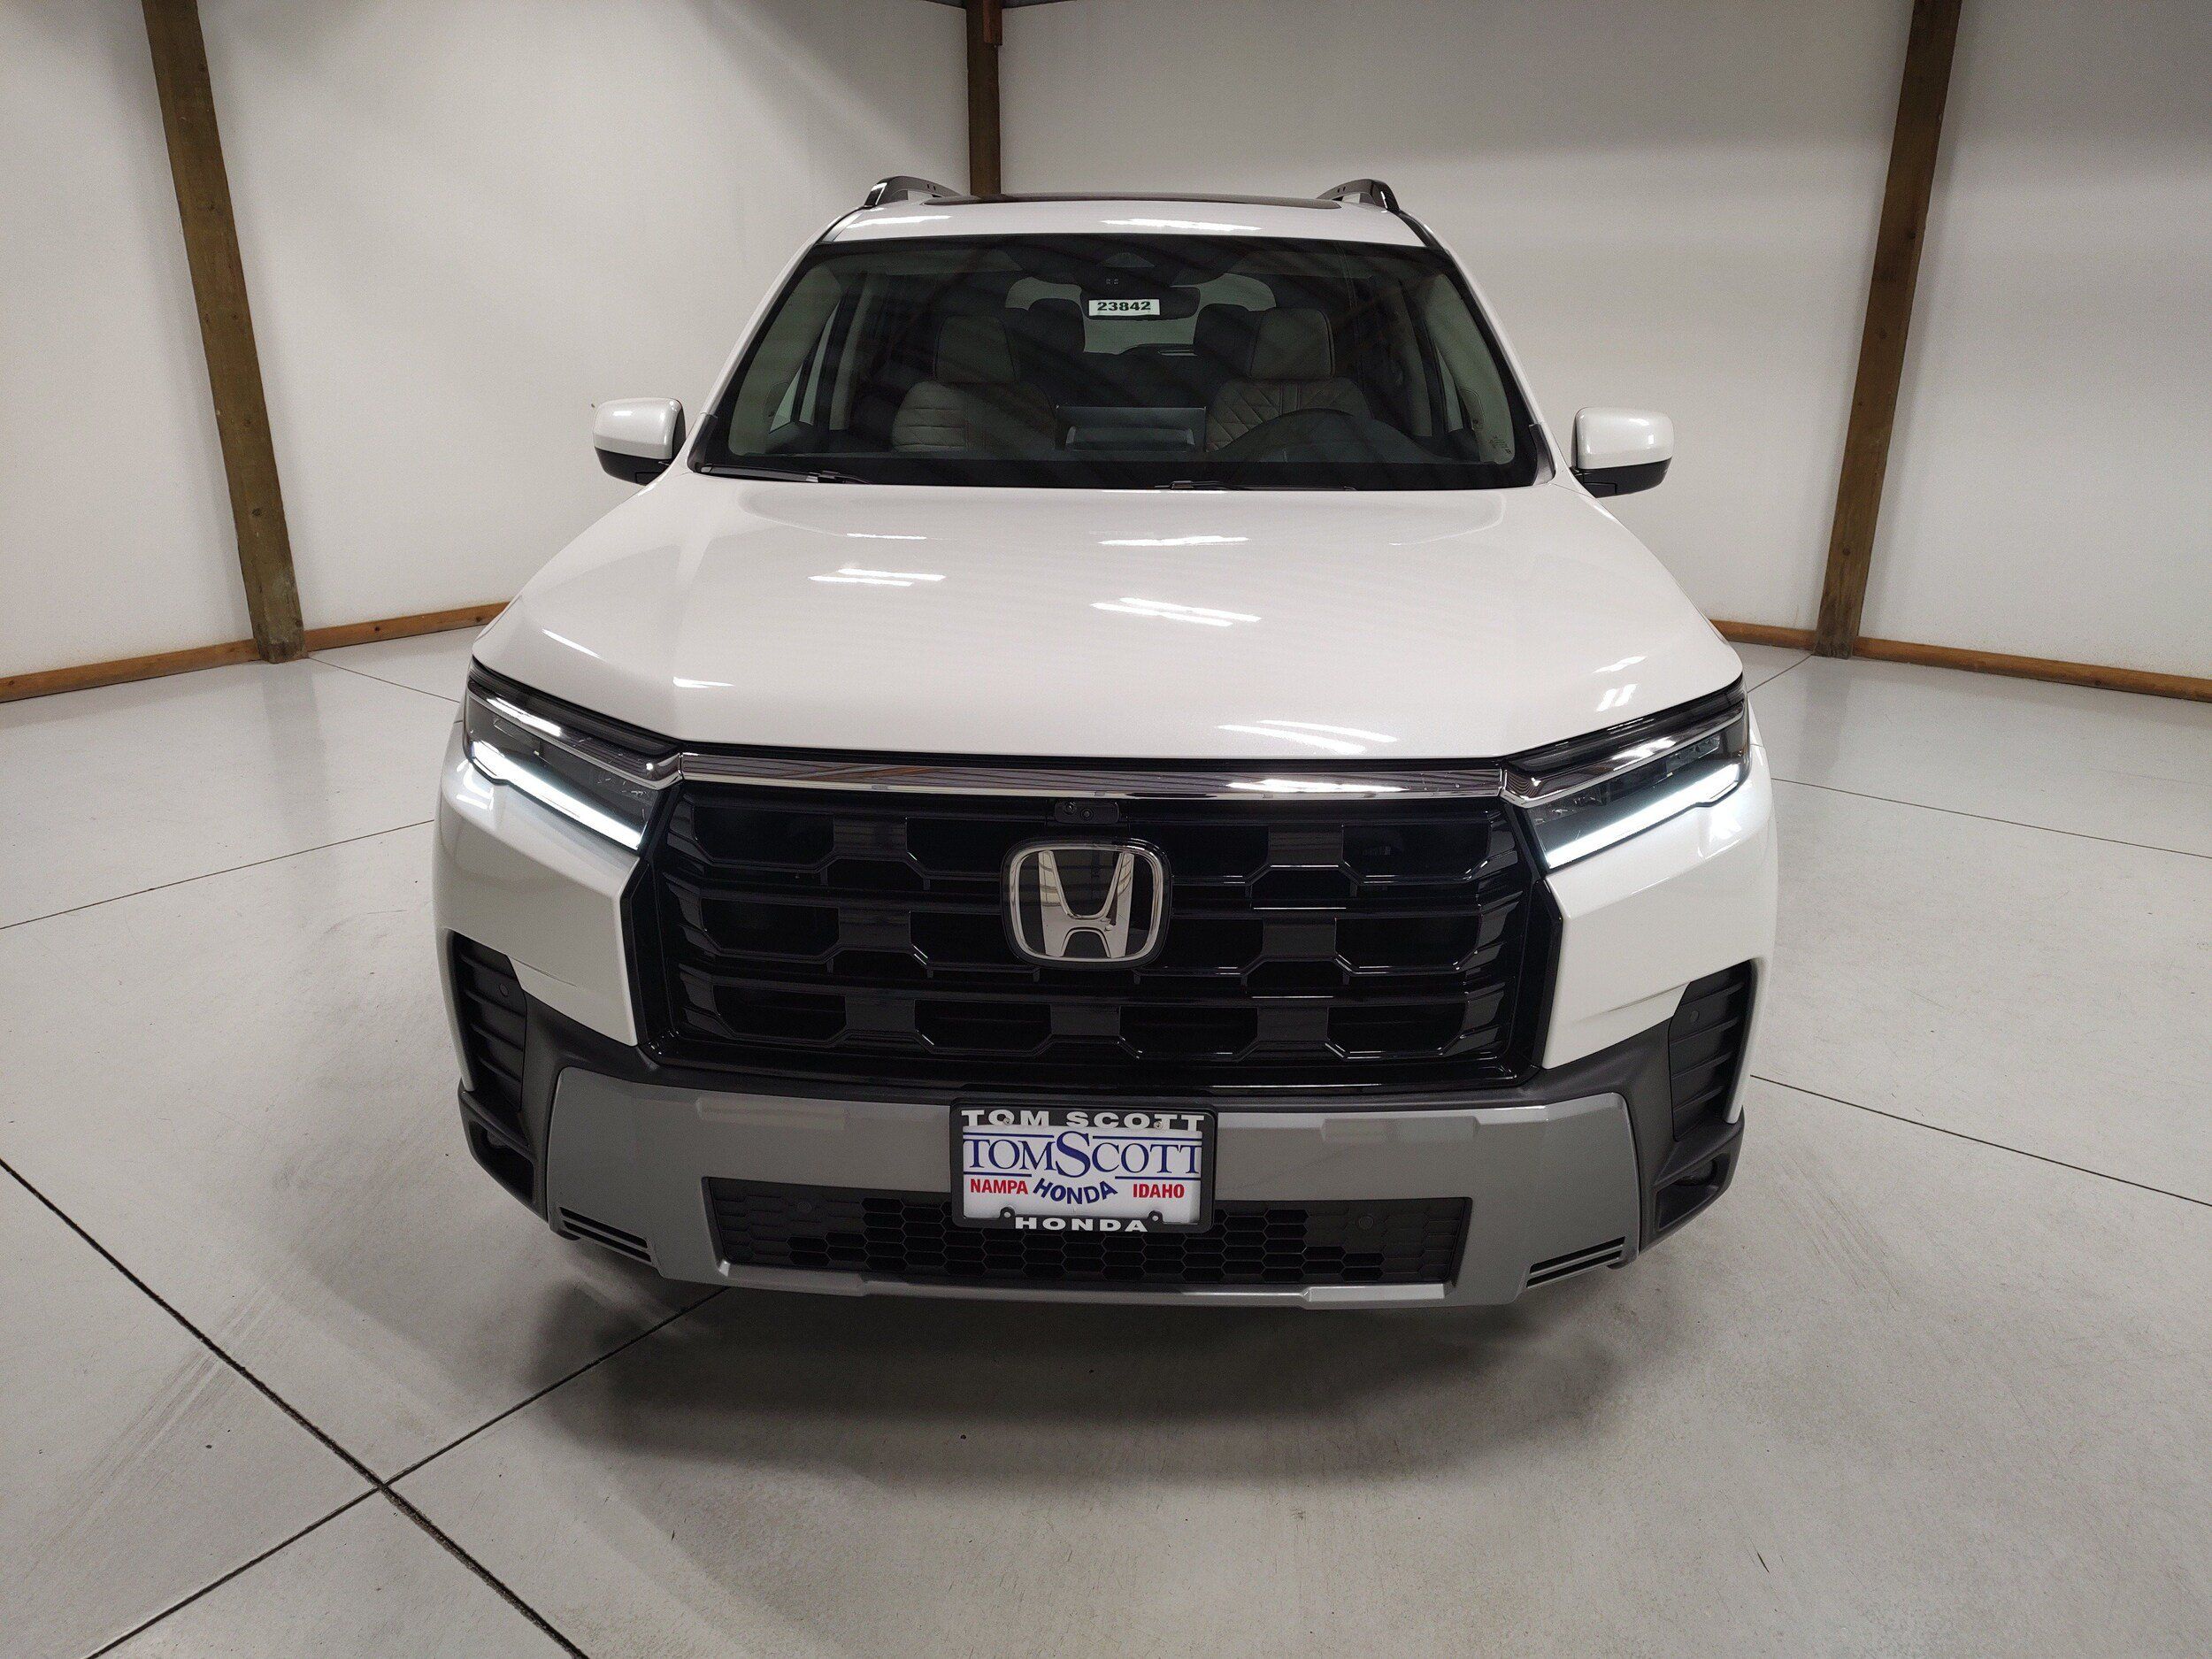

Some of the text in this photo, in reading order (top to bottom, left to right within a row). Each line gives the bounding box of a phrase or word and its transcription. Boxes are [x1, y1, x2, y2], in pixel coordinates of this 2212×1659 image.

[1097, 302, 1151, 311] 23842
[961, 1110, 1204, 1131] TOM SCOTT
[970, 1179, 1028, 1194] NAMPA
[1033, 1178, 1118, 1204] HONDA
[1133, 1184, 1185, 1198] IDAHO
[1015, 1217, 1148, 1232] HONDA
